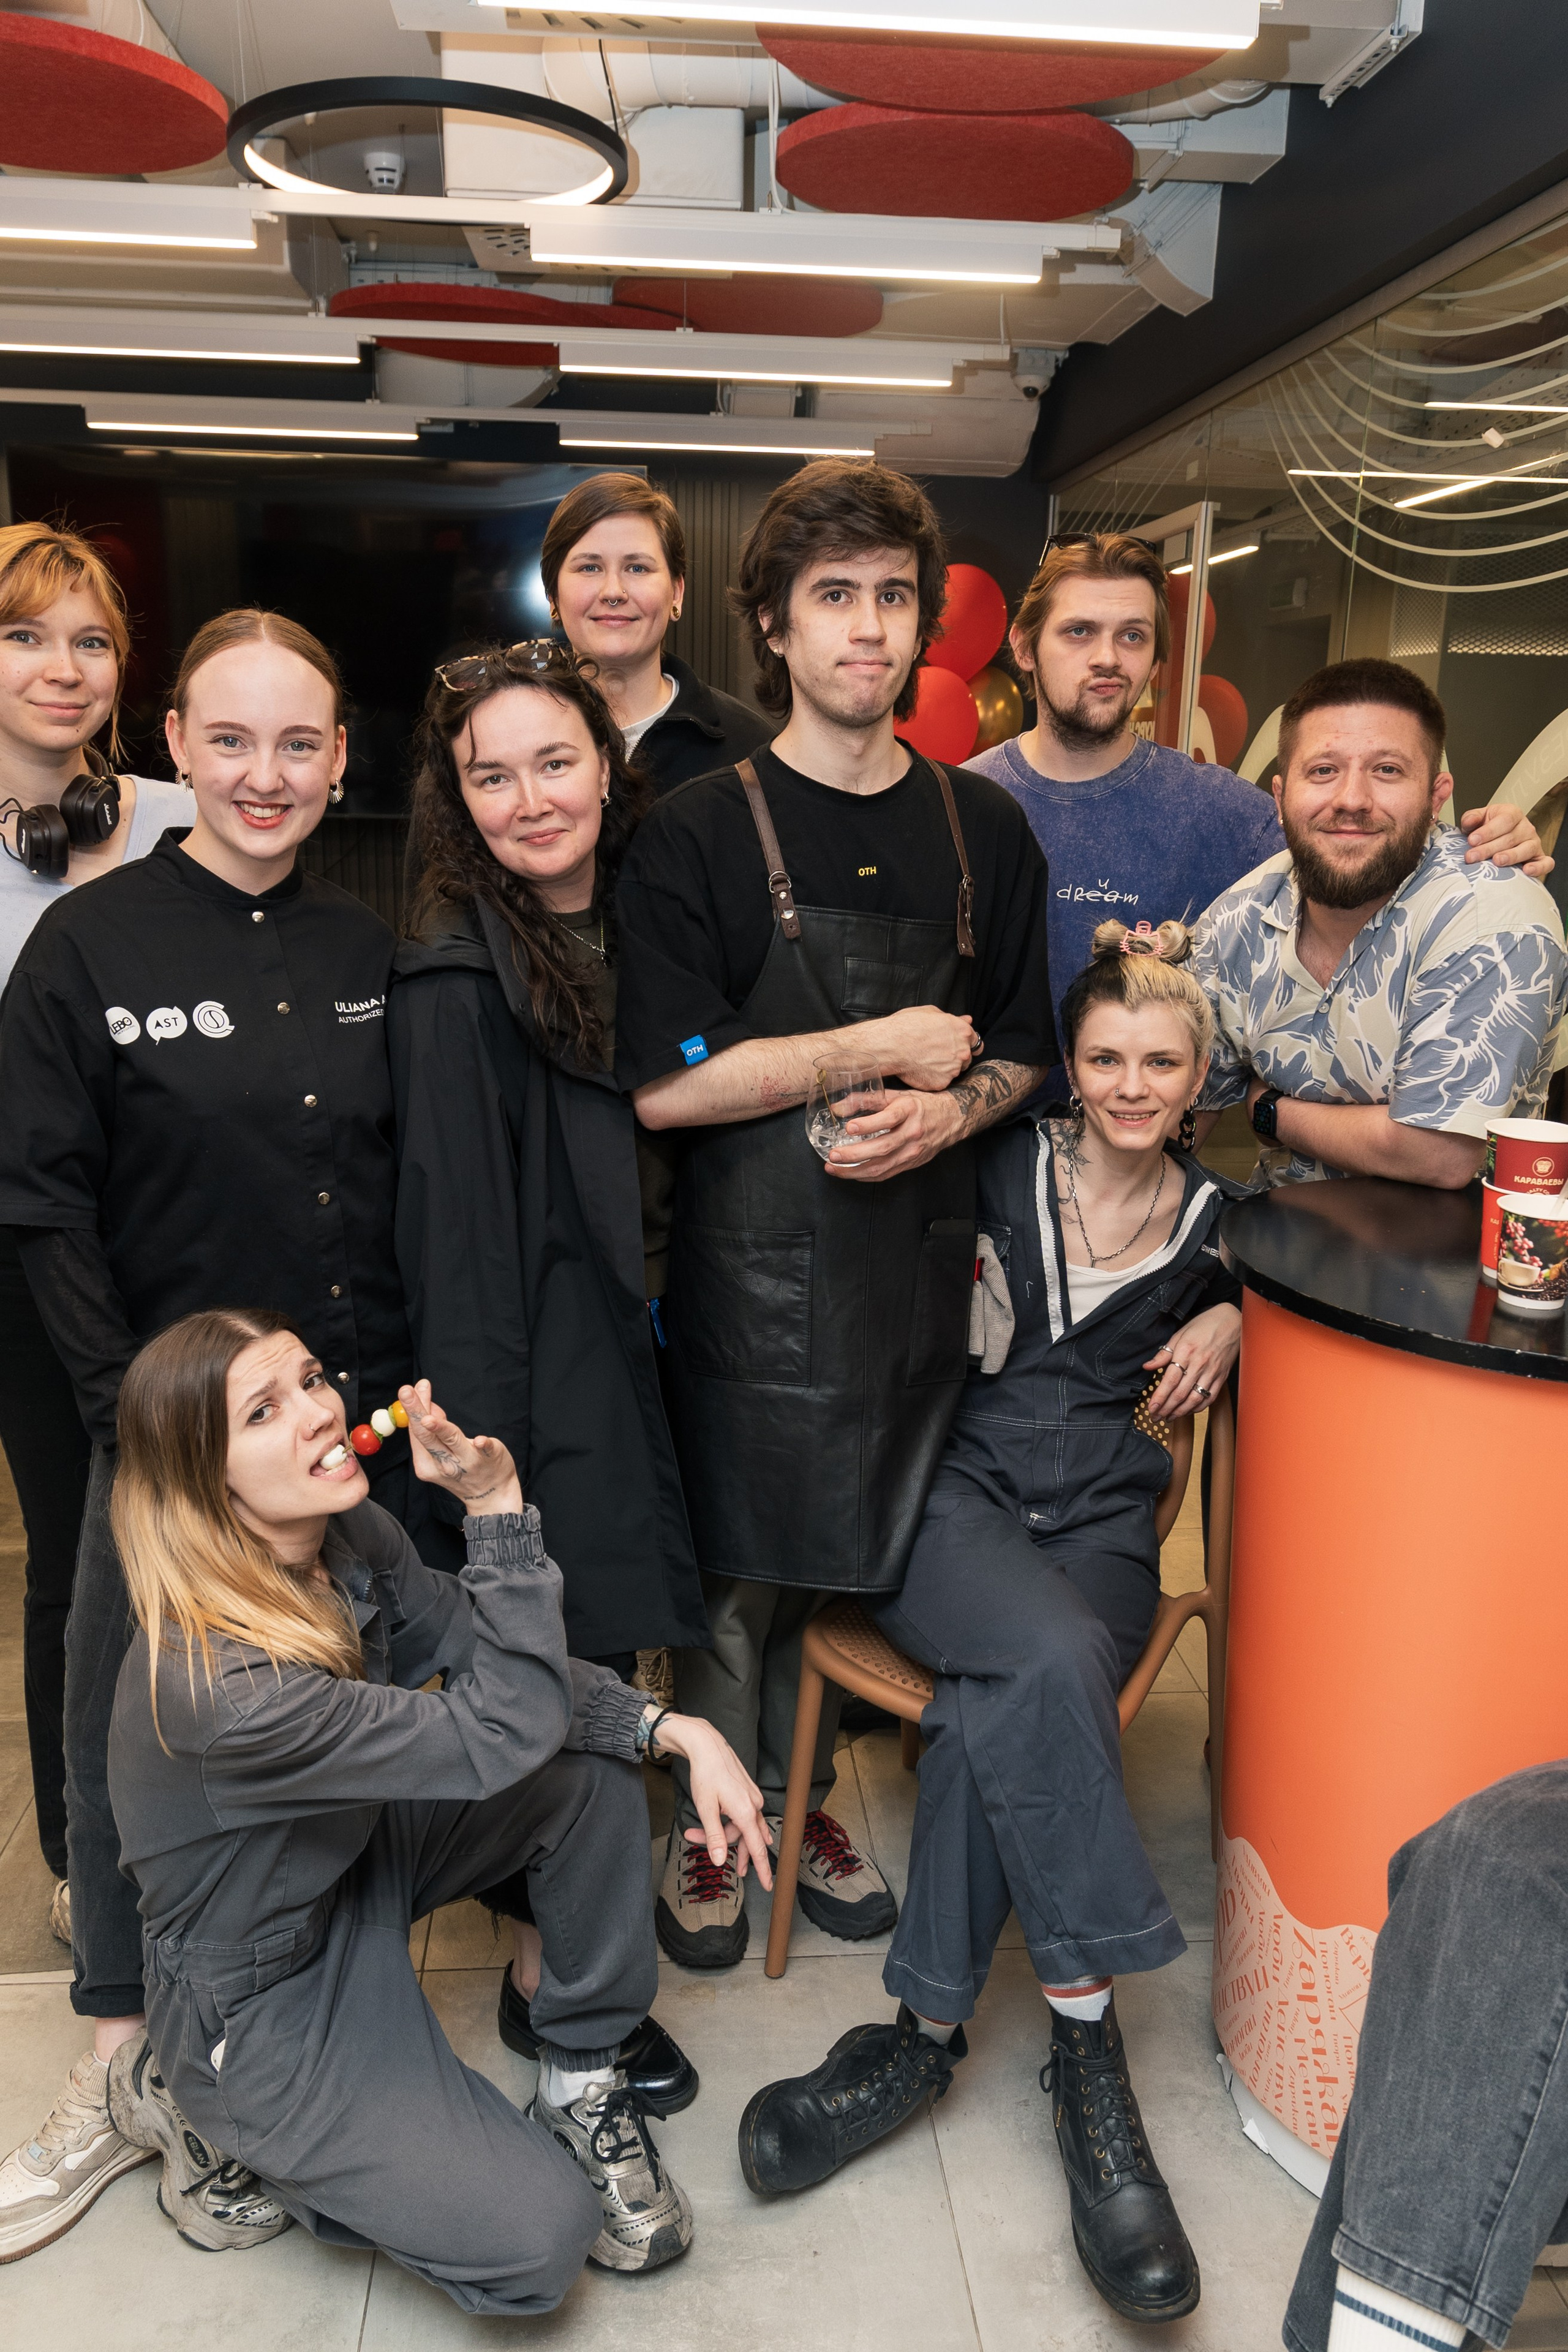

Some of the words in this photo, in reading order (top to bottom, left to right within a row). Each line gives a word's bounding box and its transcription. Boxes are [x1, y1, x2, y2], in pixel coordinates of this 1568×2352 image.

[858, 866, 877, 876] OTH
[334, 998, 380, 1012] ULIANA
[154, 1017, 179, 1030] AST
[687, 1044, 703, 1057] OTH
[1514, 1175, 1564, 1186] КАРАВАЕВЫ
